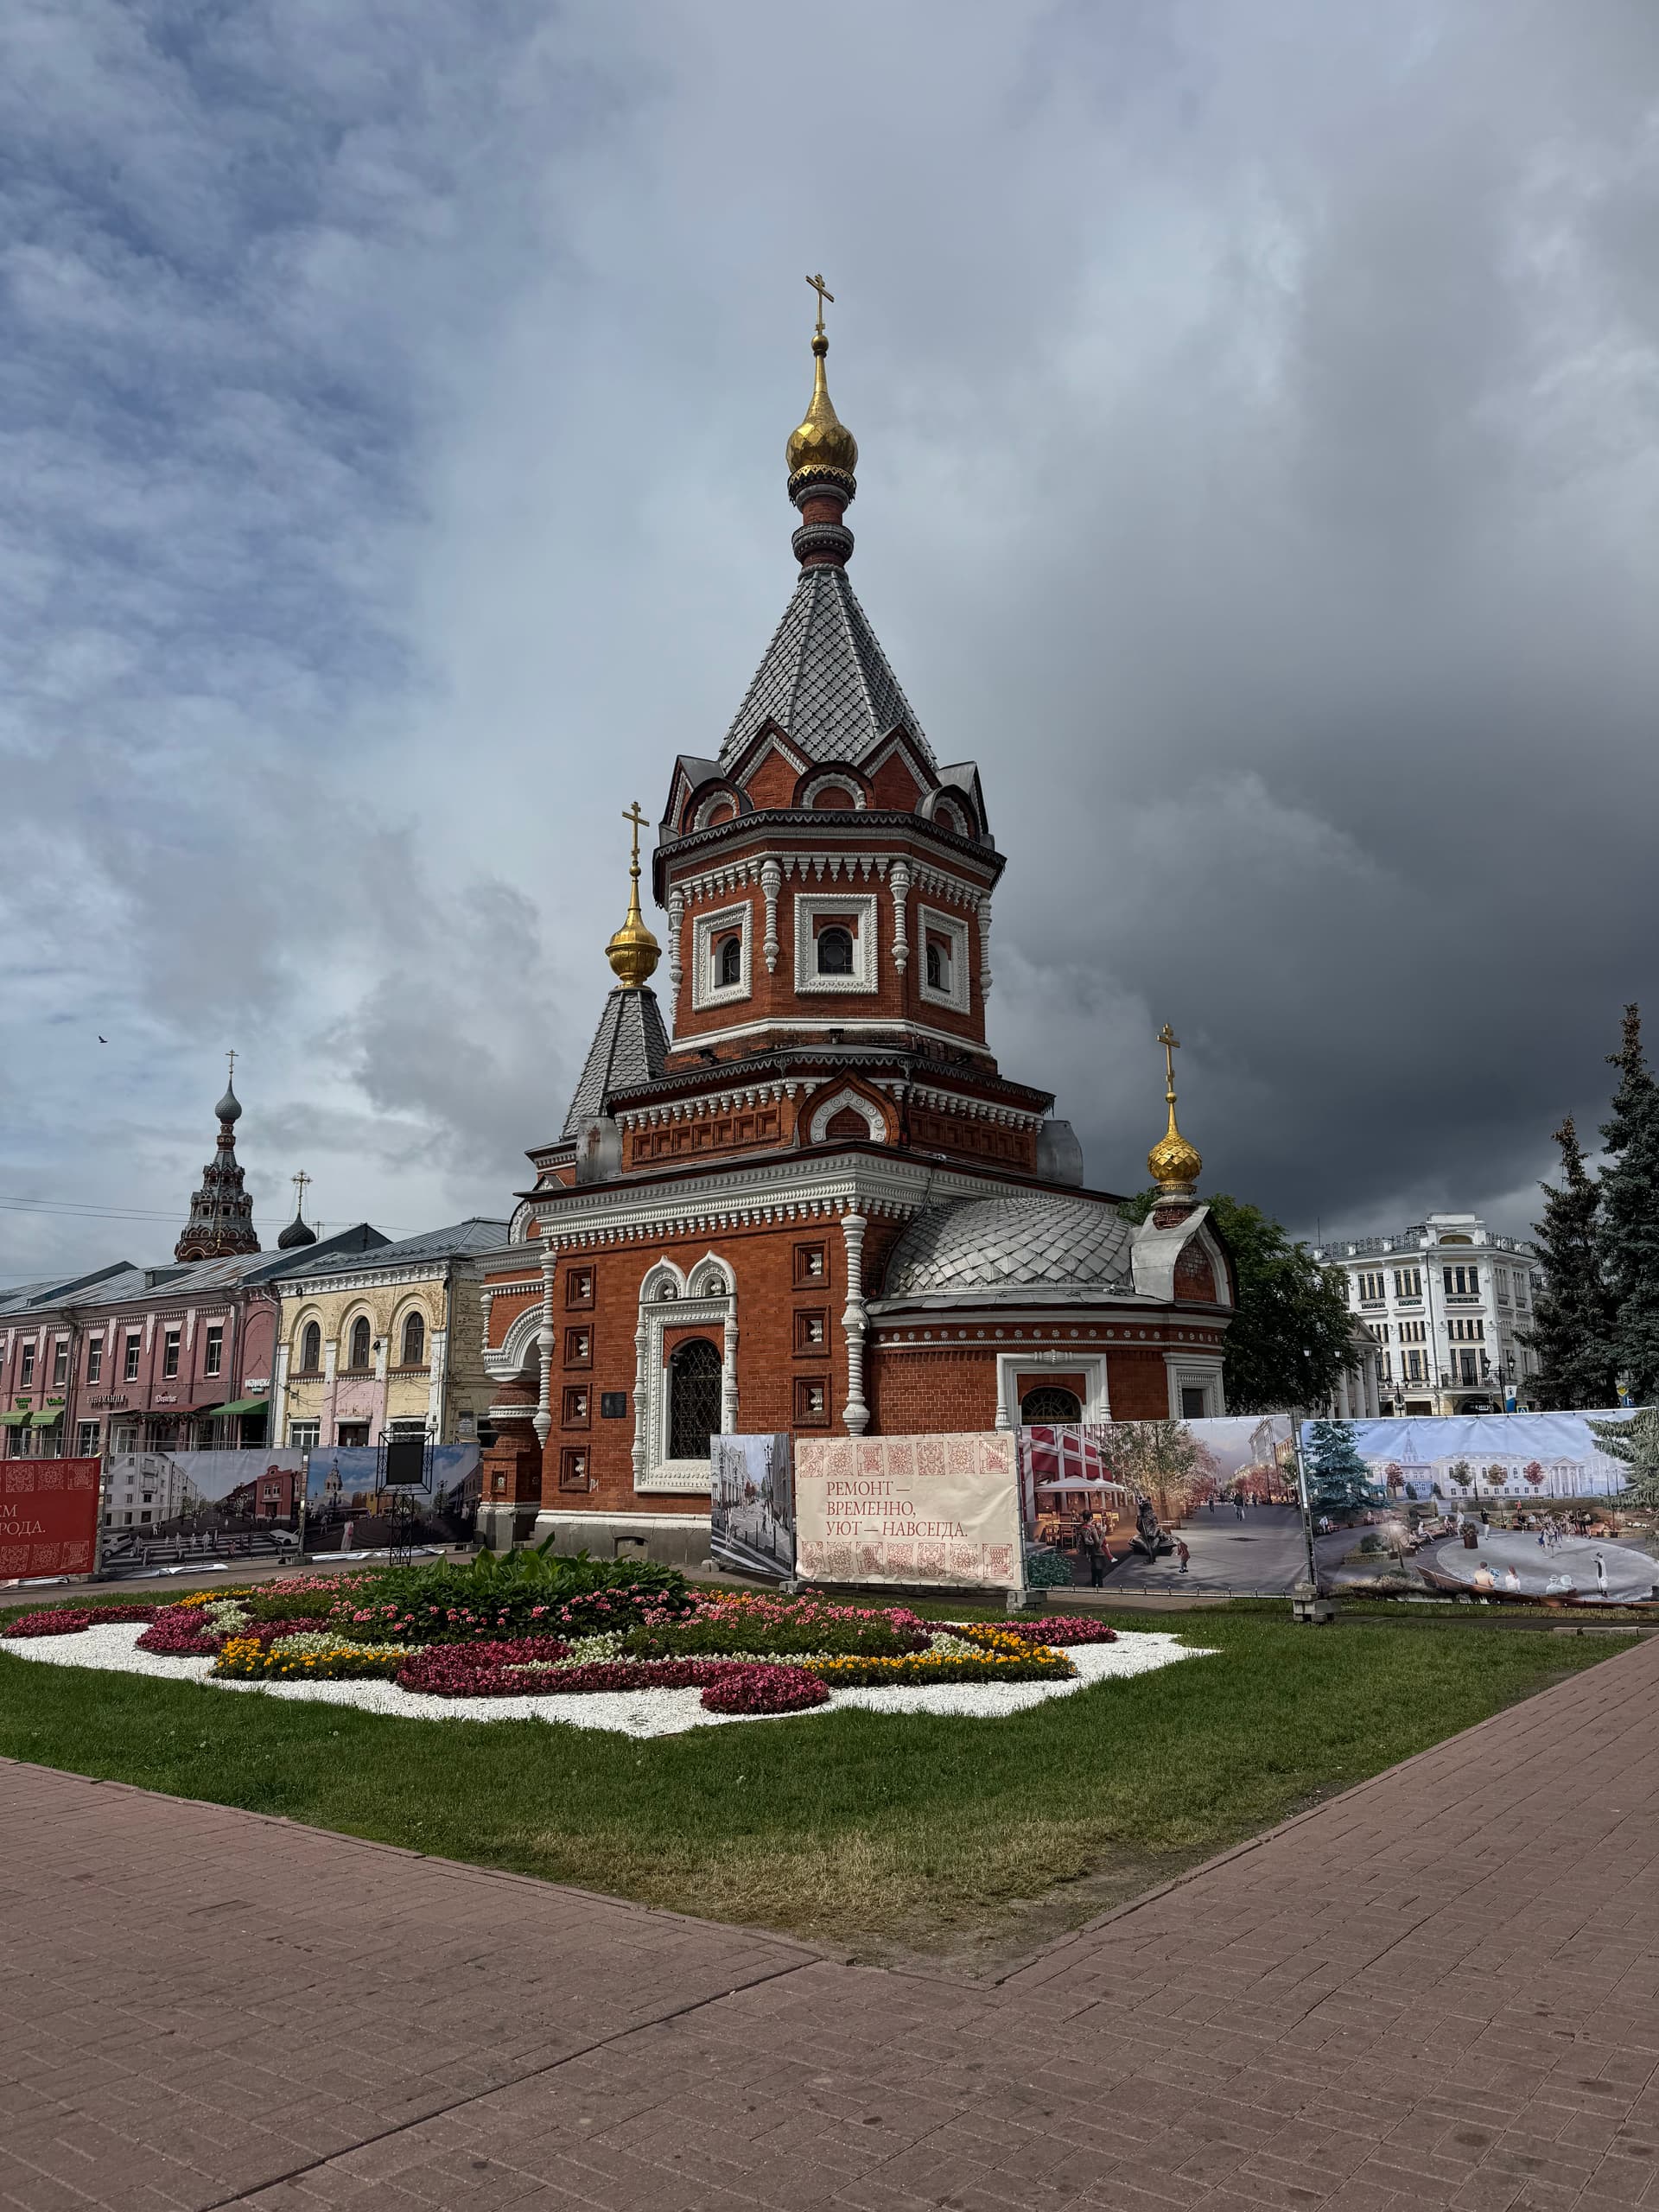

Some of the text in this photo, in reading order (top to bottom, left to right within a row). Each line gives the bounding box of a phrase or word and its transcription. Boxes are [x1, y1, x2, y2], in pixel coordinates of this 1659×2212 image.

[826, 1481, 893, 1496] РЕМОНТ
[826, 1501, 916, 1518] ВРЕМЕННО,
[826, 1521, 862, 1536] УЮТ
[882, 1521, 968, 1540] НАВСЕГДА.
